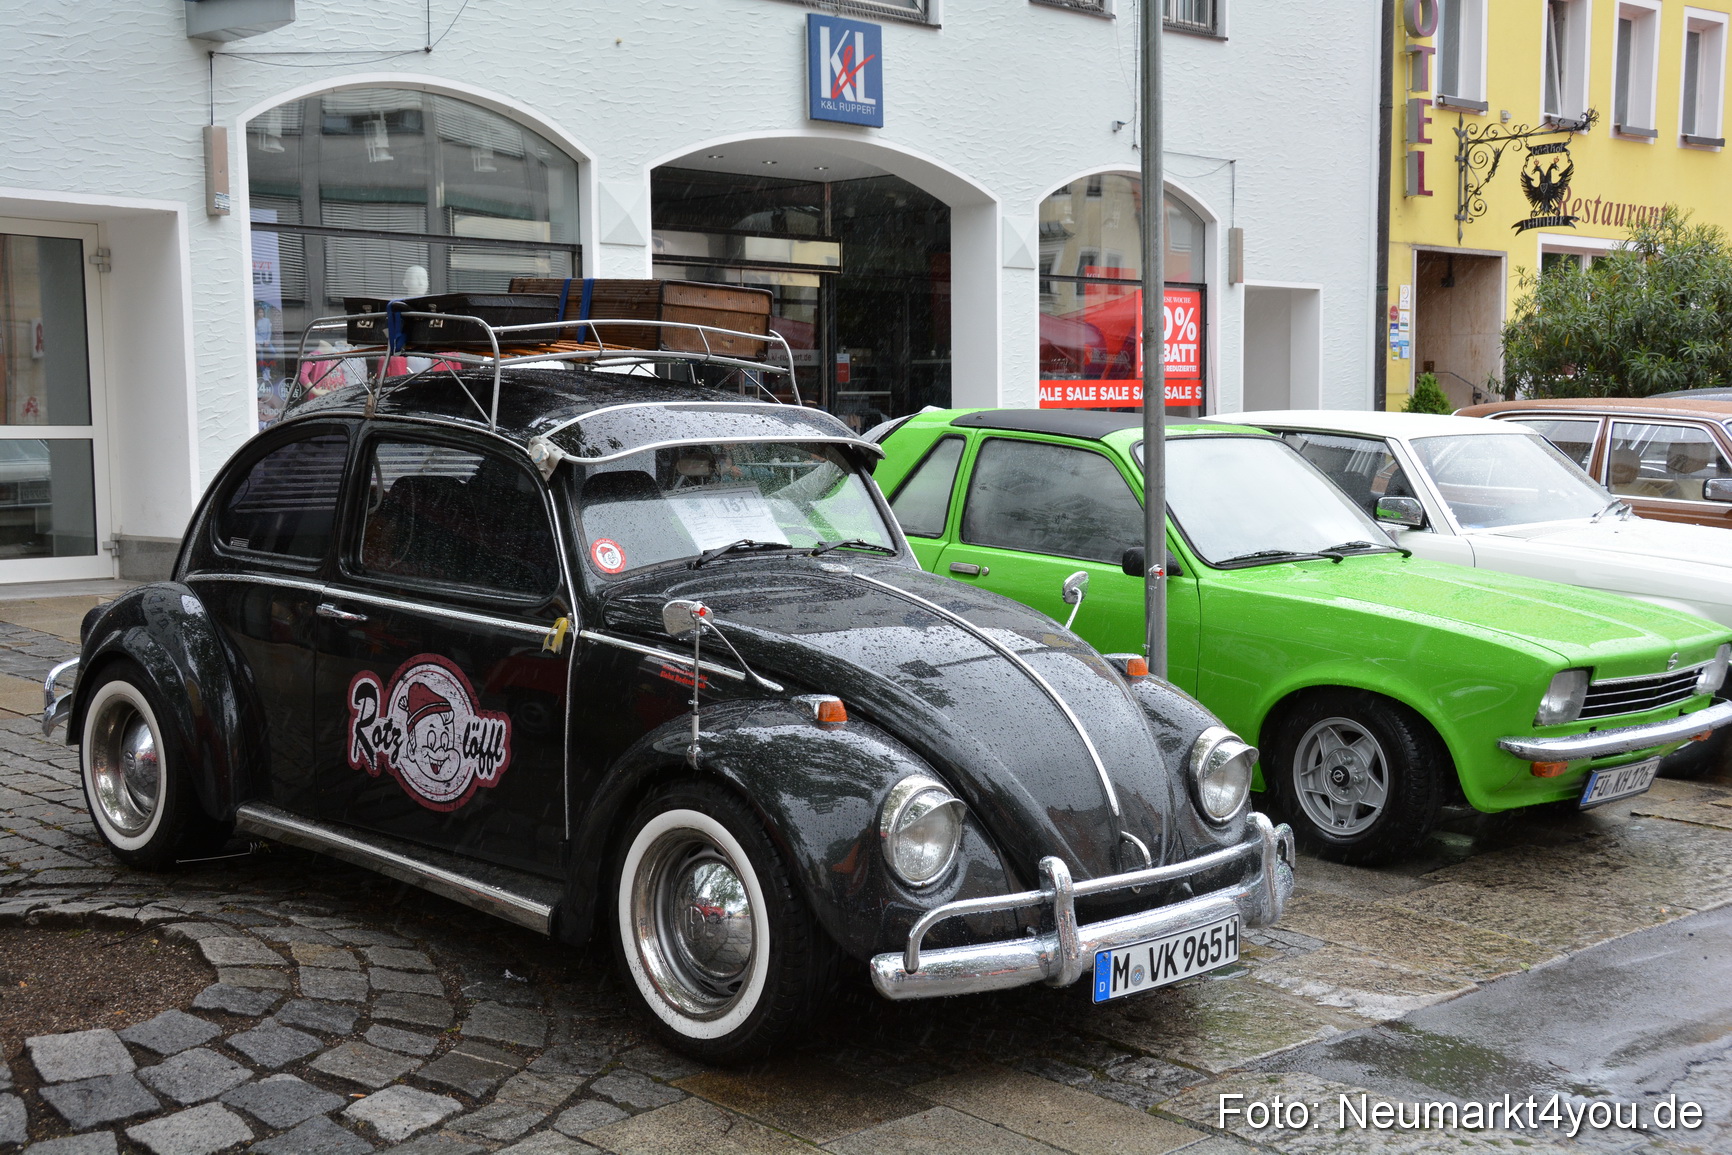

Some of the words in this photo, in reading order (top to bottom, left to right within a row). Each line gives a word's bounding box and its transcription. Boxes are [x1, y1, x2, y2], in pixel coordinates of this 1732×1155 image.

[820, 26, 876, 105] K&L
[821, 100, 838, 111] K&L
[839, 102, 876, 116] RUPPERT
[1556, 185, 1668, 230] Restaurant
[1066, 387, 1097, 401] SALE
[1099, 387, 1130, 401] SALE
[1164, 386, 1191, 400] SALE
[720, 496, 750, 513] 151
[354, 682, 403, 769] Rotz
[463, 721, 503, 776] löffl
[1112, 952, 1131, 992] M
[1099, 981, 1106, 992] D
